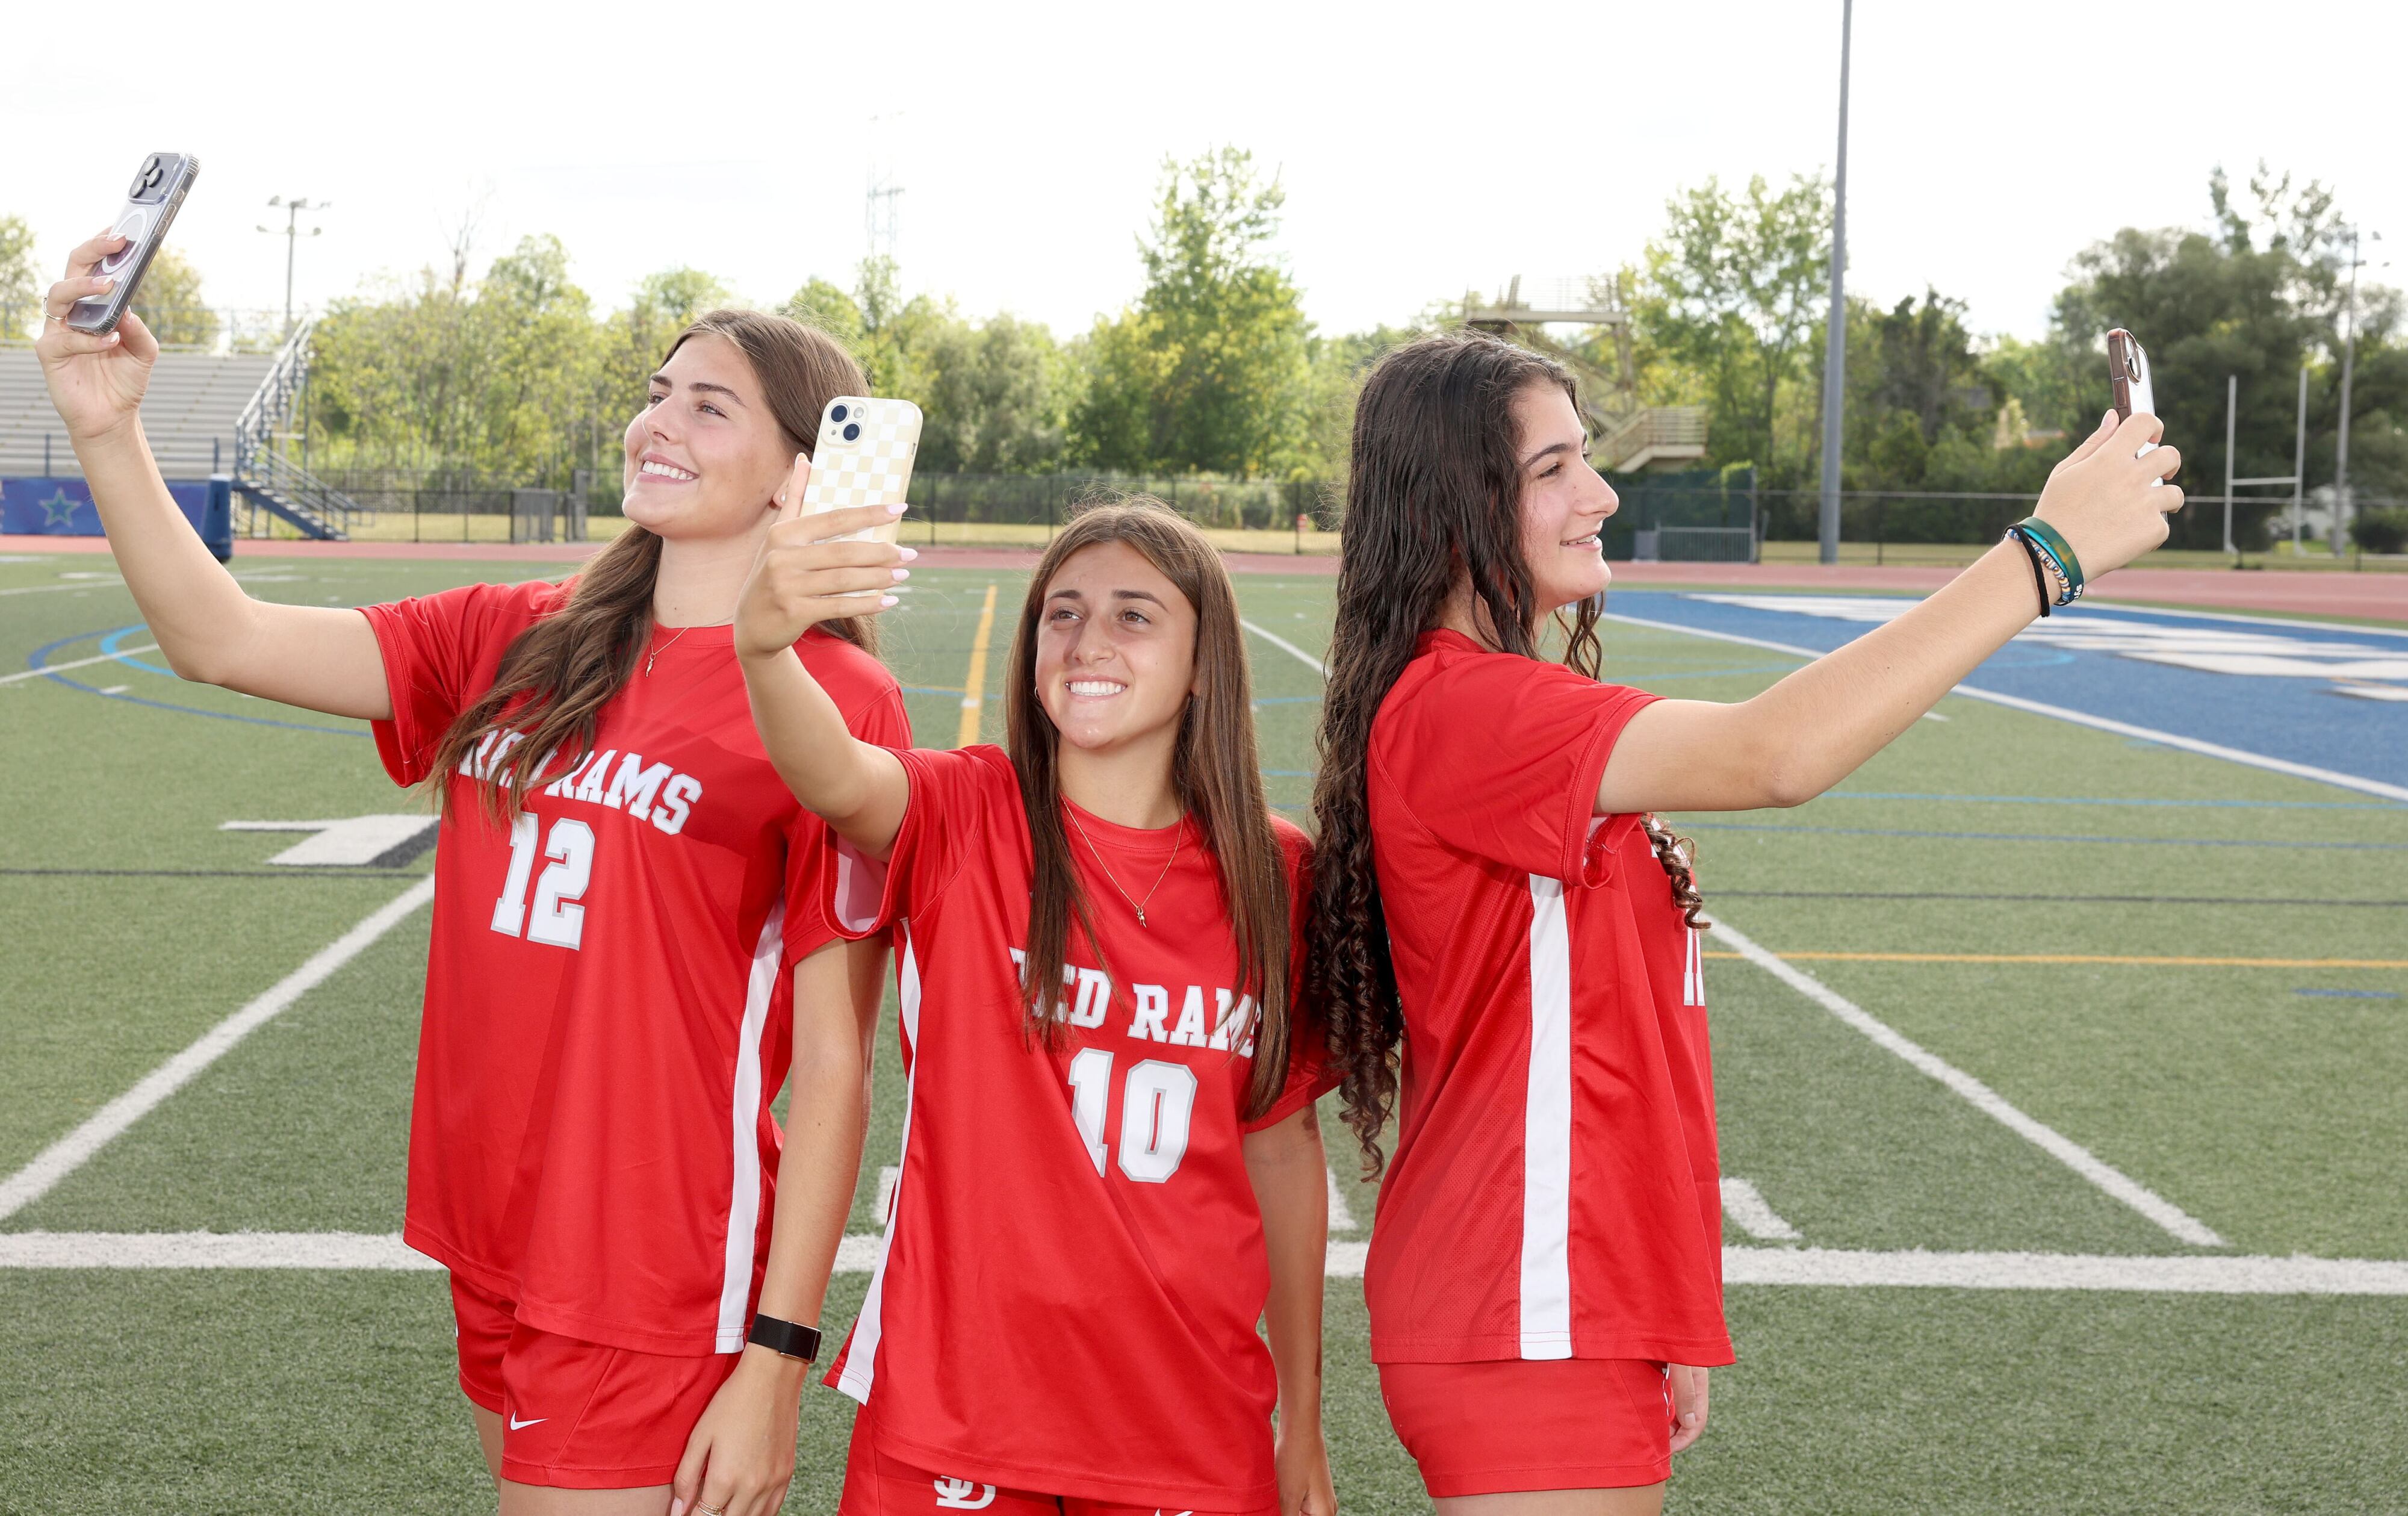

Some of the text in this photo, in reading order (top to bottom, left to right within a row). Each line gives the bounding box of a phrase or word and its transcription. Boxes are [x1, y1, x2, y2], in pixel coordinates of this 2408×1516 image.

[544, 750, 703, 835] RAMS
[491, 811, 595, 951] 12
[1068, 1047, 1198, 1183] 10
